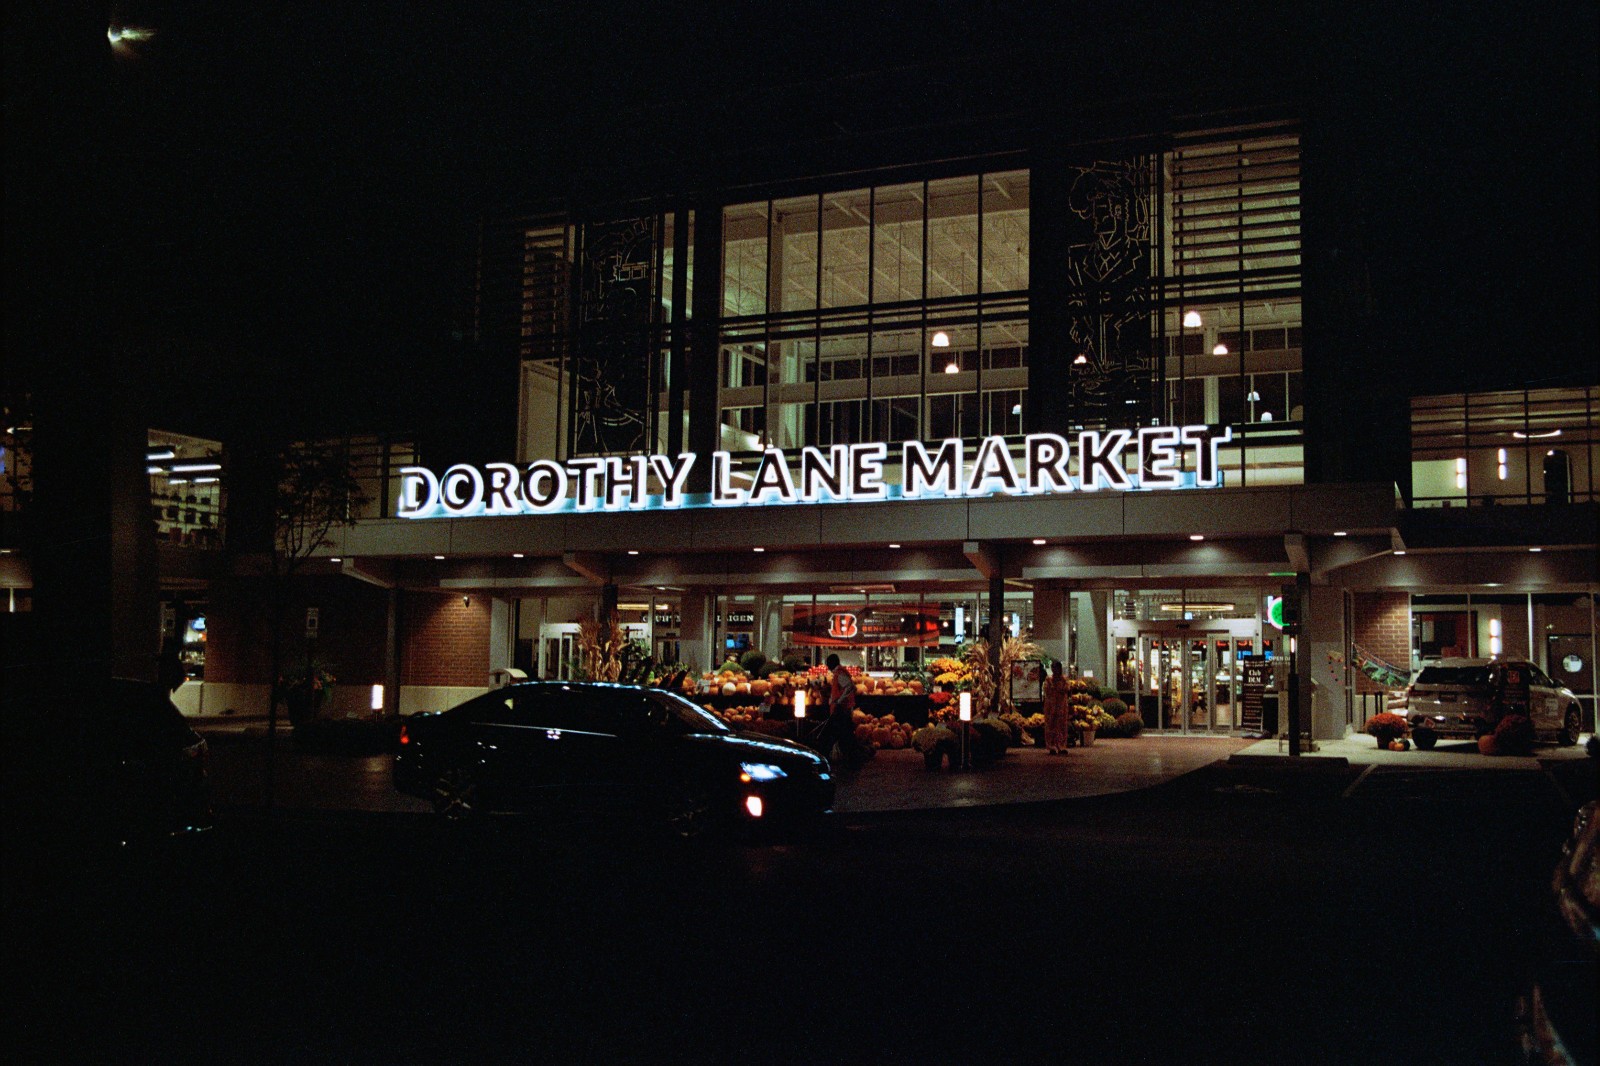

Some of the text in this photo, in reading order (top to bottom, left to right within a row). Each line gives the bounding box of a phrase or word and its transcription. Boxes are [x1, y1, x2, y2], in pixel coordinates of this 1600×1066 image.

[397, 424, 1233, 518] DOROTHY LANE MARKET
